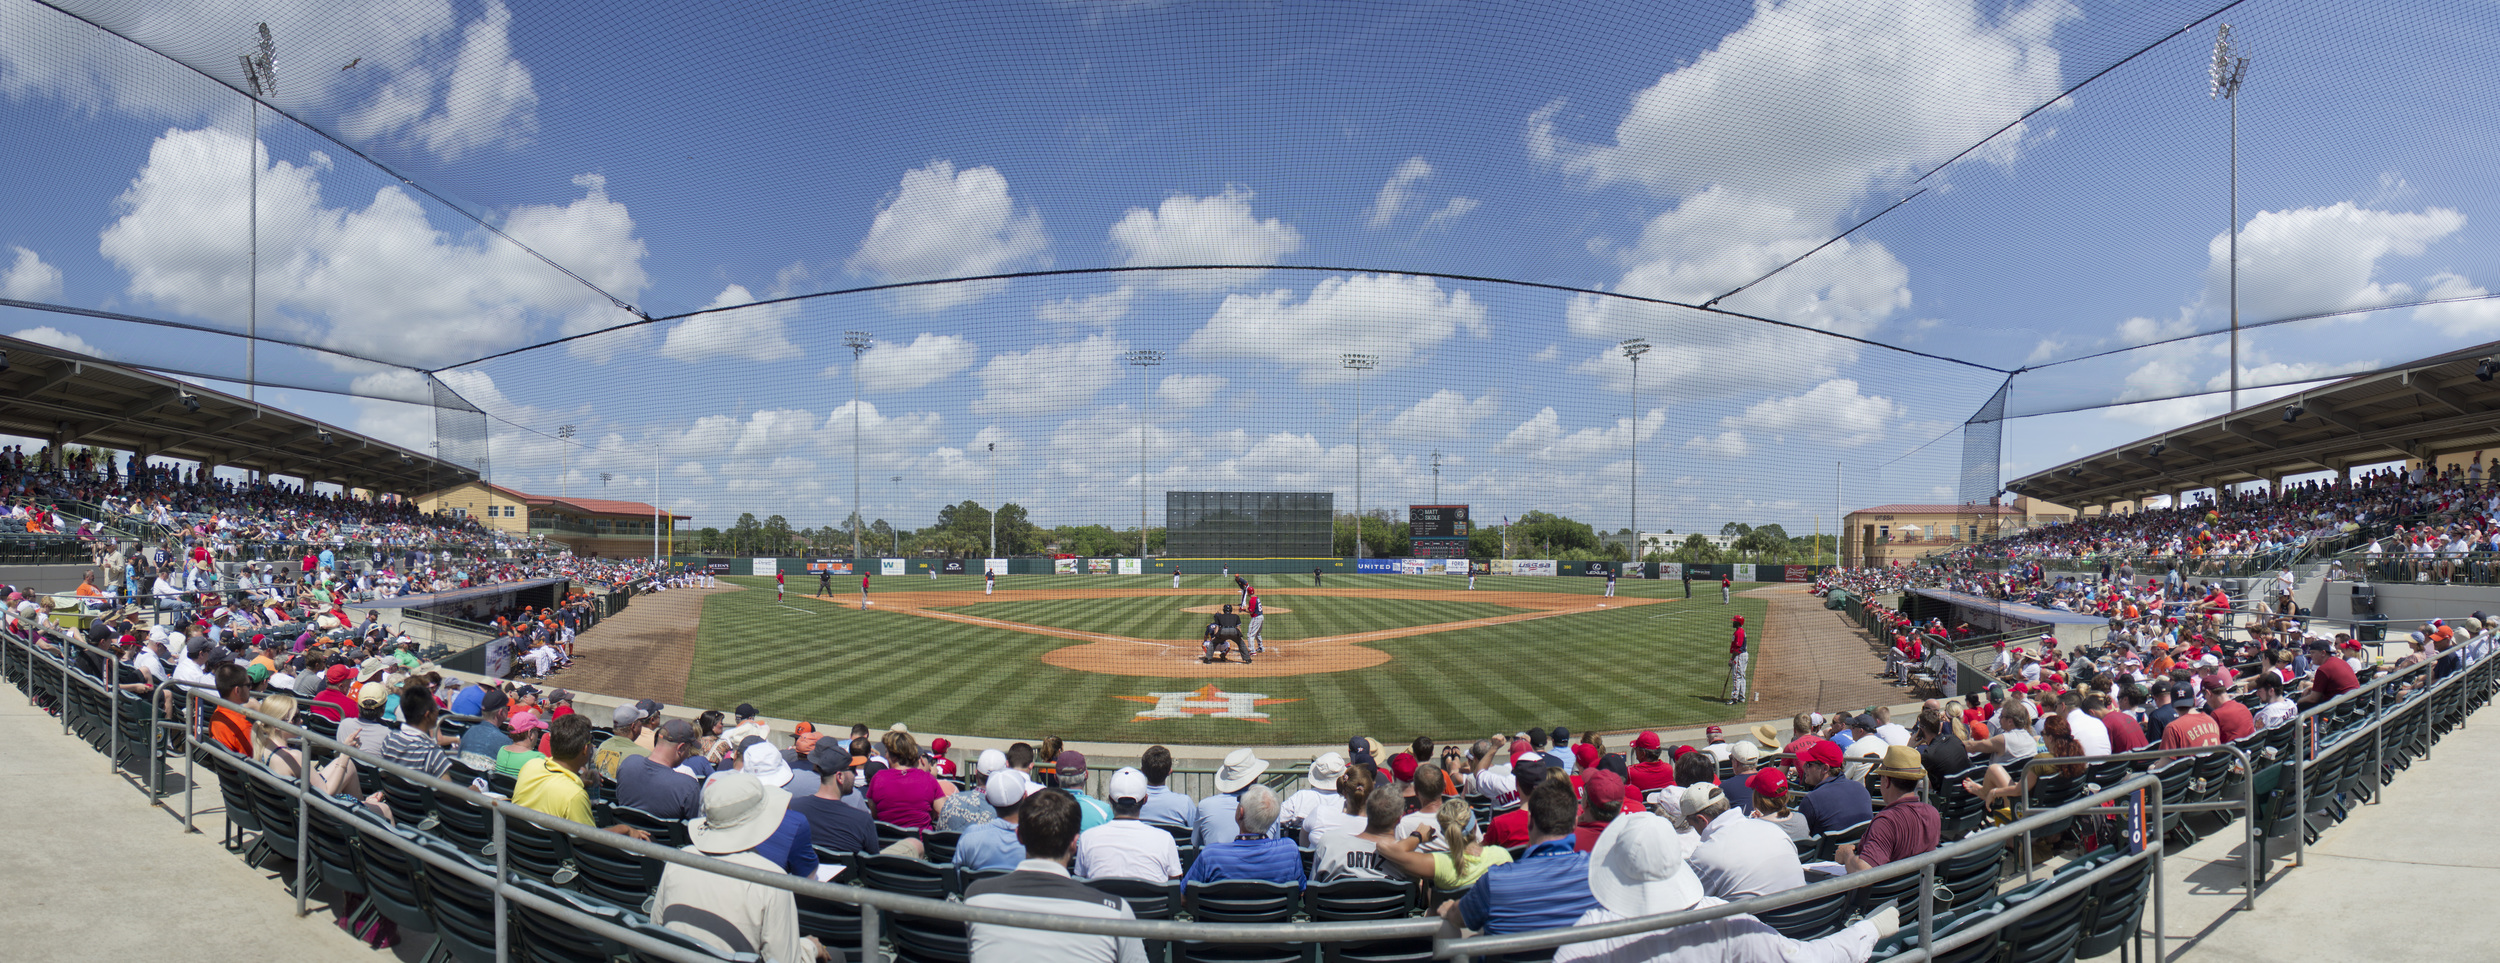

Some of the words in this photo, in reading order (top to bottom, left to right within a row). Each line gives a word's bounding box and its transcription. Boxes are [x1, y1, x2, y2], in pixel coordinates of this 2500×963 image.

[1410, 509, 1424, 520] 63
[2133, 802, 2141, 844] 110
[1346, 850, 1386, 871] ORTIZ
